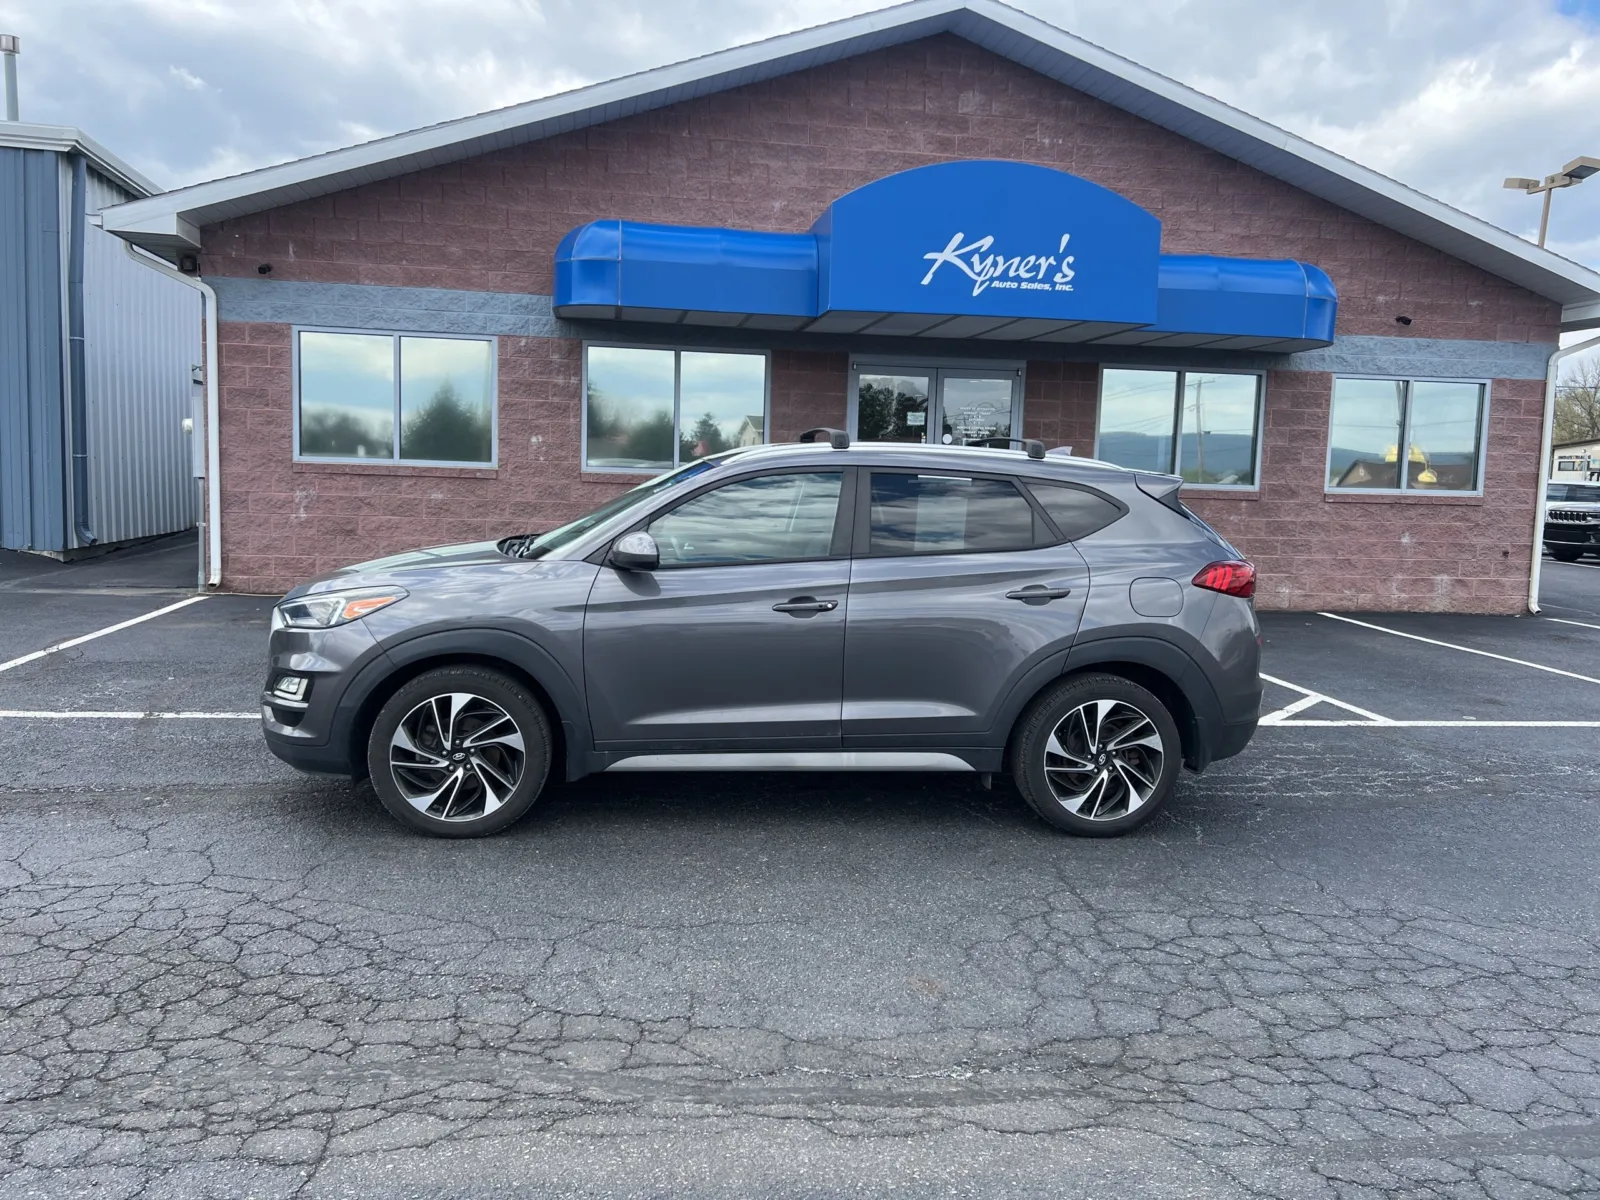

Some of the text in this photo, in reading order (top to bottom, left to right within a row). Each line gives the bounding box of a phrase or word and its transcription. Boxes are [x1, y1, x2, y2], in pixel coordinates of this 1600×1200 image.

[920, 231, 1075, 297] Kyner's
[990, 280, 1074, 291] Auto Sales, Inc.
